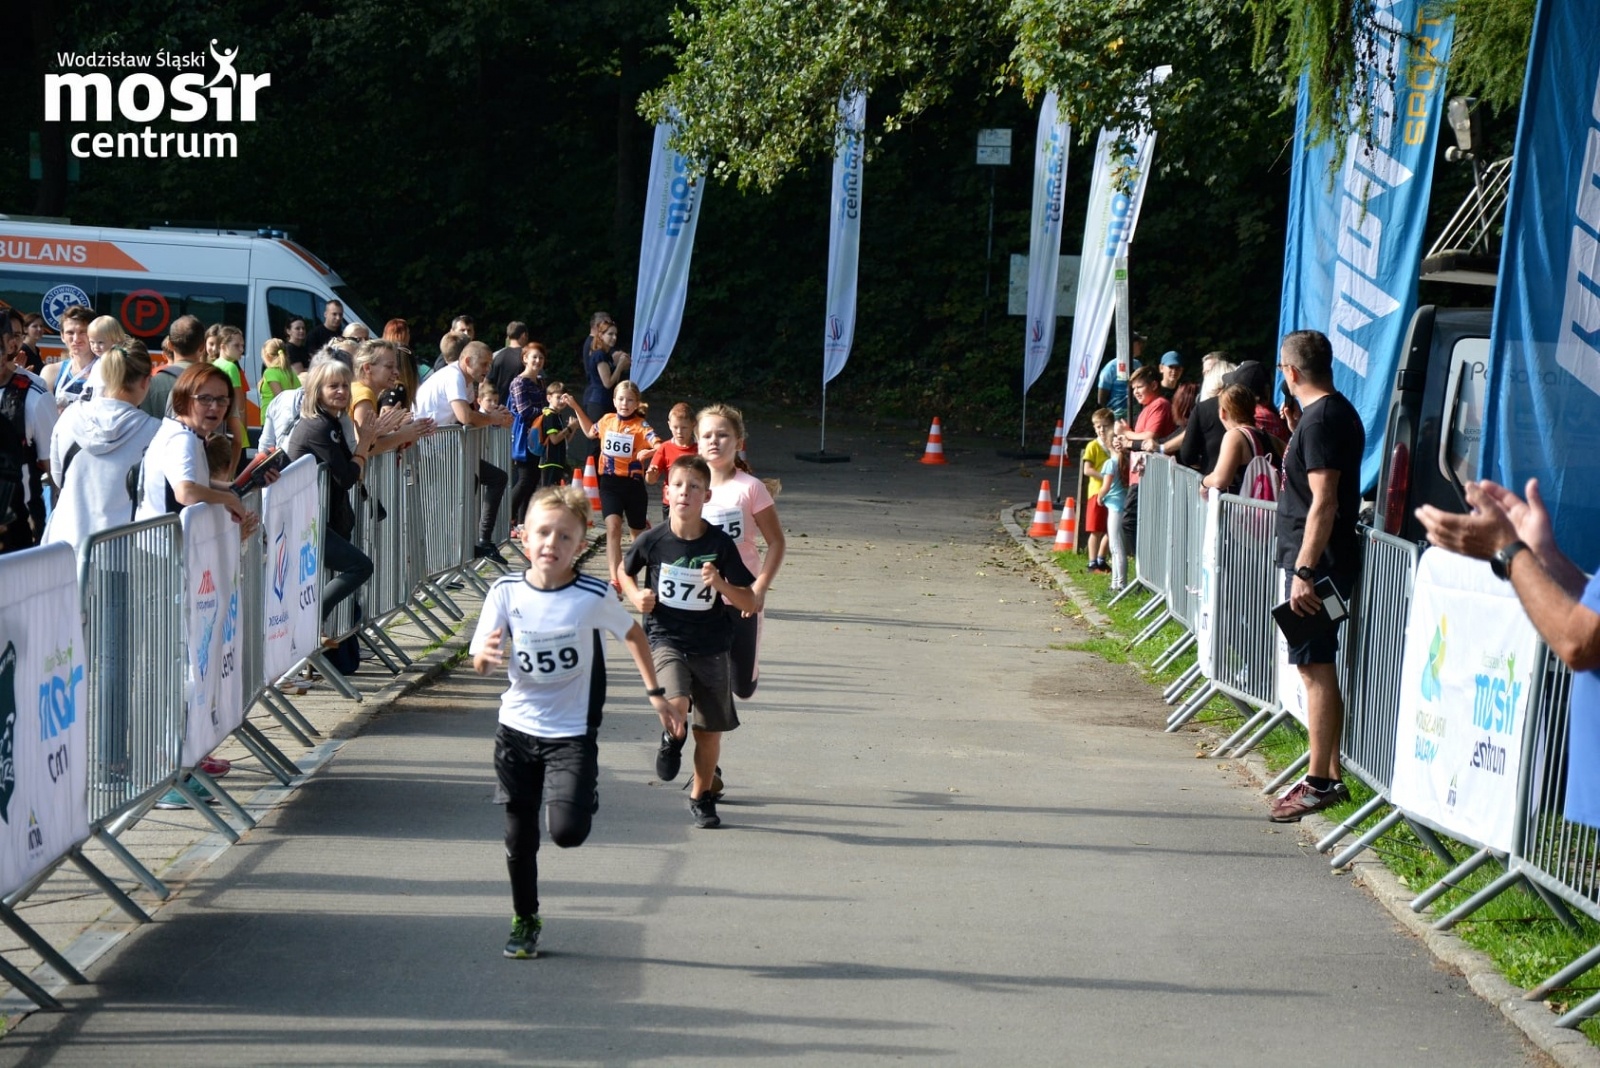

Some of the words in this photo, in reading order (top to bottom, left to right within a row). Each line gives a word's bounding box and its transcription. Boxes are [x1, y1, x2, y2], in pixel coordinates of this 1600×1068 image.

[1403, 9, 1442, 146] SPORT
[666, 155, 690, 237] mos
[605, 439, 631, 453] 366
[661, 580, 713, 603] 374
[517, 646, 579, 674] 359
